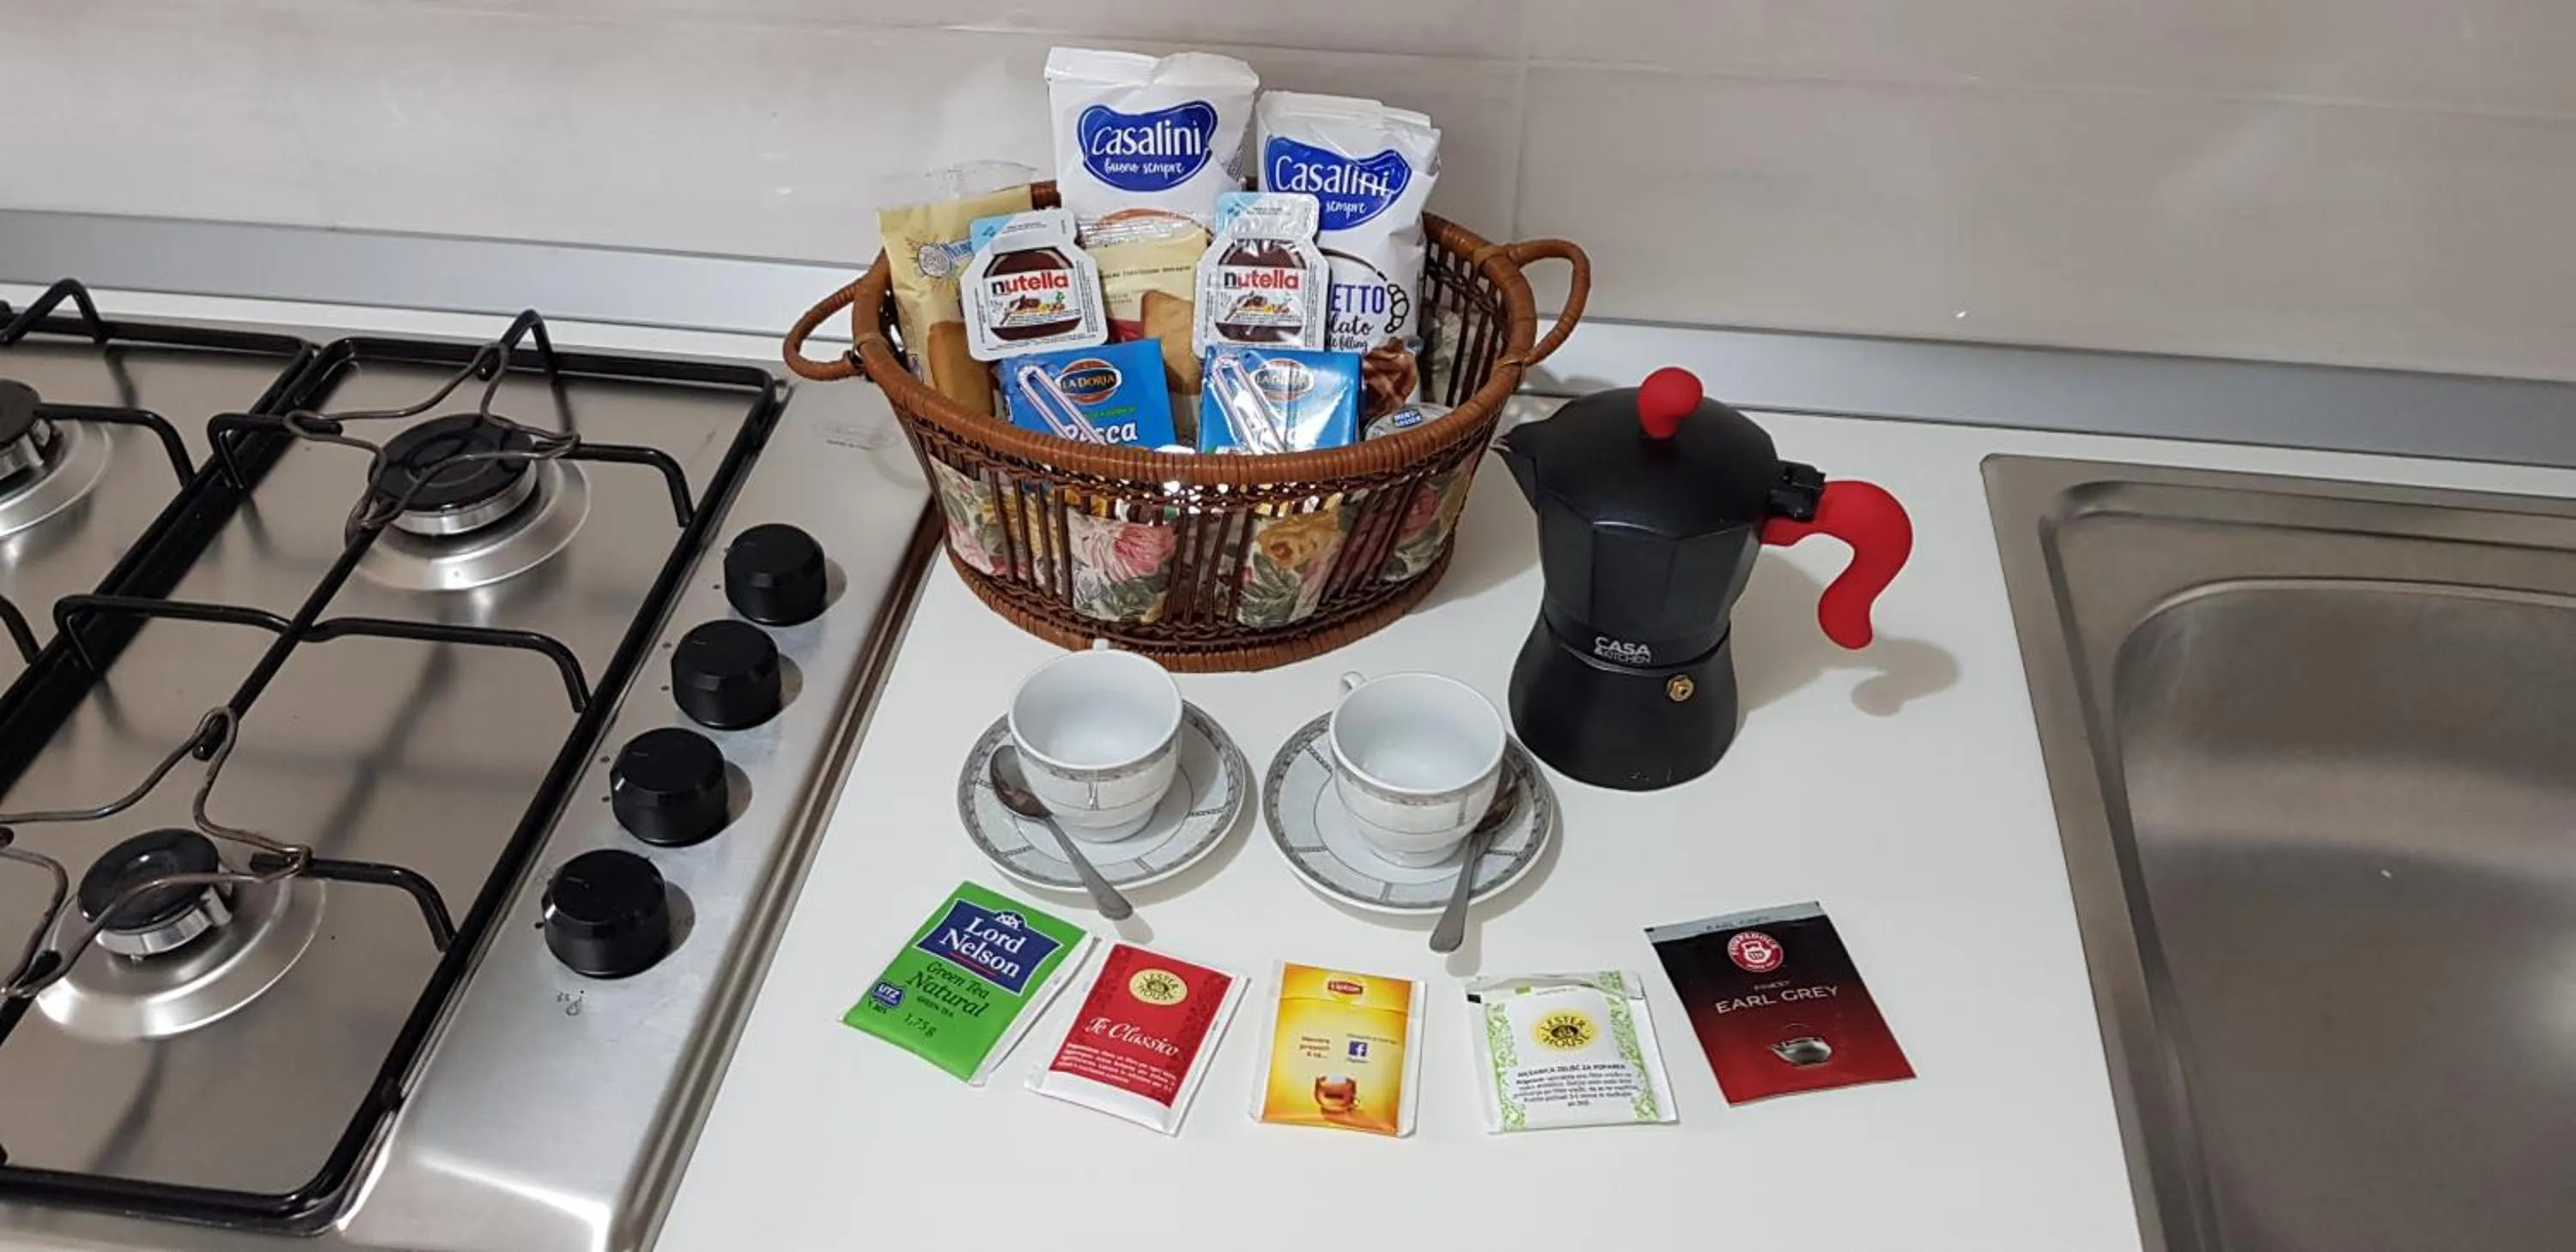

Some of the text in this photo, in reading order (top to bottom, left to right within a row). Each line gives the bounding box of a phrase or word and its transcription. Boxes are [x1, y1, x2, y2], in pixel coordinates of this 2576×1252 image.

[1091, 119, 1201, 155] Casalini
[1104, 157, 1184, 179] buono sempre
[1275, 155, 1389, 197] Casalini
[1325, 199, 1367, 220] sempre
[991, 271, 1069, 295] nutella
[1224, 269, 1299, 289] nutella
[1595, 635, 1651, 655] CASA
[963, 916, 1028, 955] Lord
[939, 927, 1022, 979] Nelson
[878, 983, 901, 997] UTZ
[927, 961, 990, 1000] Green Tea
[904, 970, 990, 1018] Natural
[1716, 986, 1838, 1014] EARL GREY
[1540, 1015, 1586, 1032] LESTER
[1108, 1023, 1180, 1056] Classico
[1542, 1032, 1590, 1047] HOUSE
